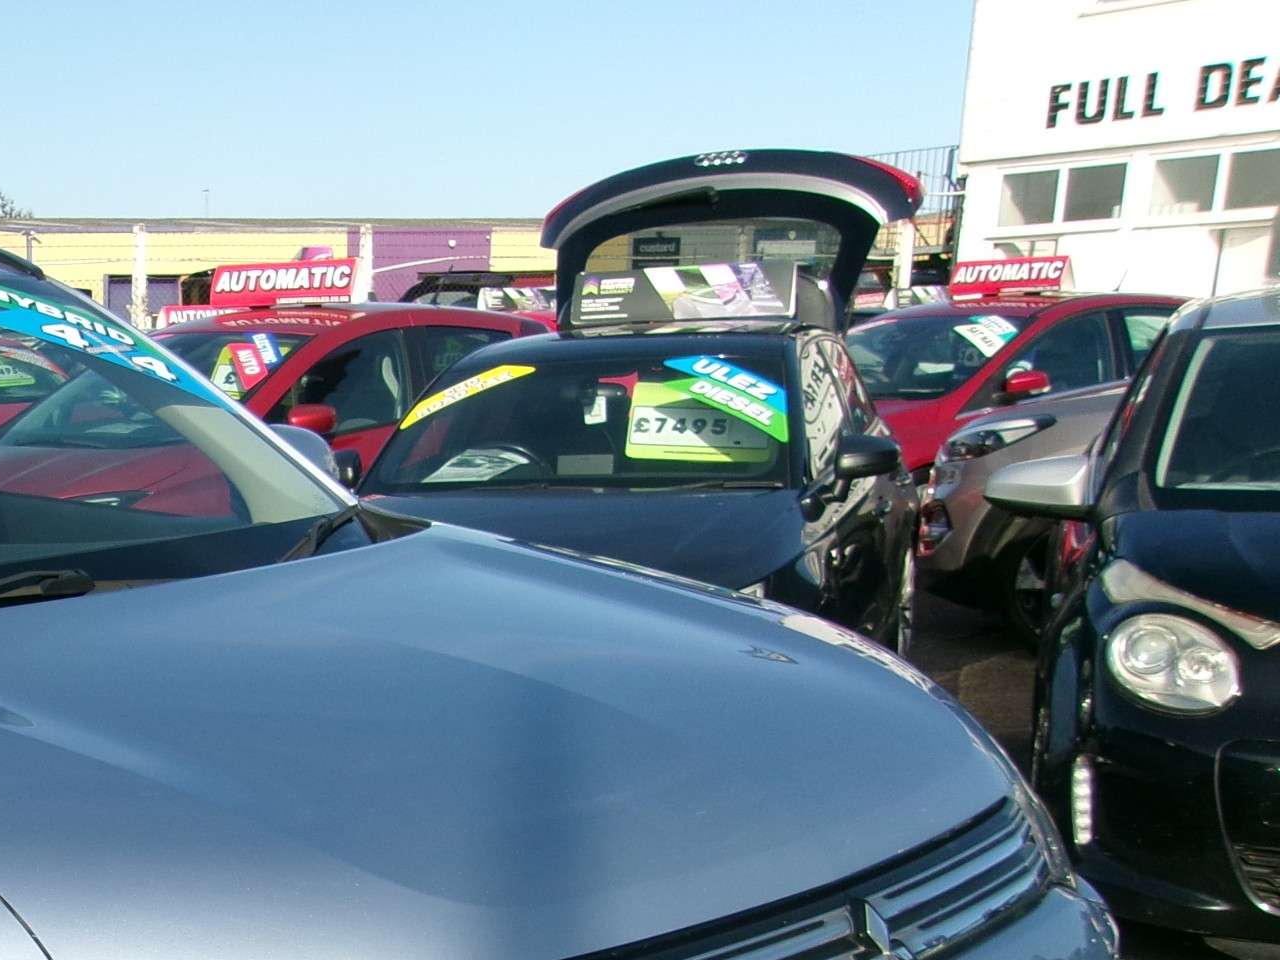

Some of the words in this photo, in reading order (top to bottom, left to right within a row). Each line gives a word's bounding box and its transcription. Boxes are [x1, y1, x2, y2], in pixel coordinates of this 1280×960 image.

[1045, 72, 1165, 129] FULL
[215, 265, 352, 293] AUTOMATIC
[953, 260, 1064, 283] AUTOMATIC
[236, 349, 261, 376] AUTO
[692, 358, 778, 401] ULEZ
[688, 380, 774, 427] DIESEL
[633, 416, 728, 436] £7495
